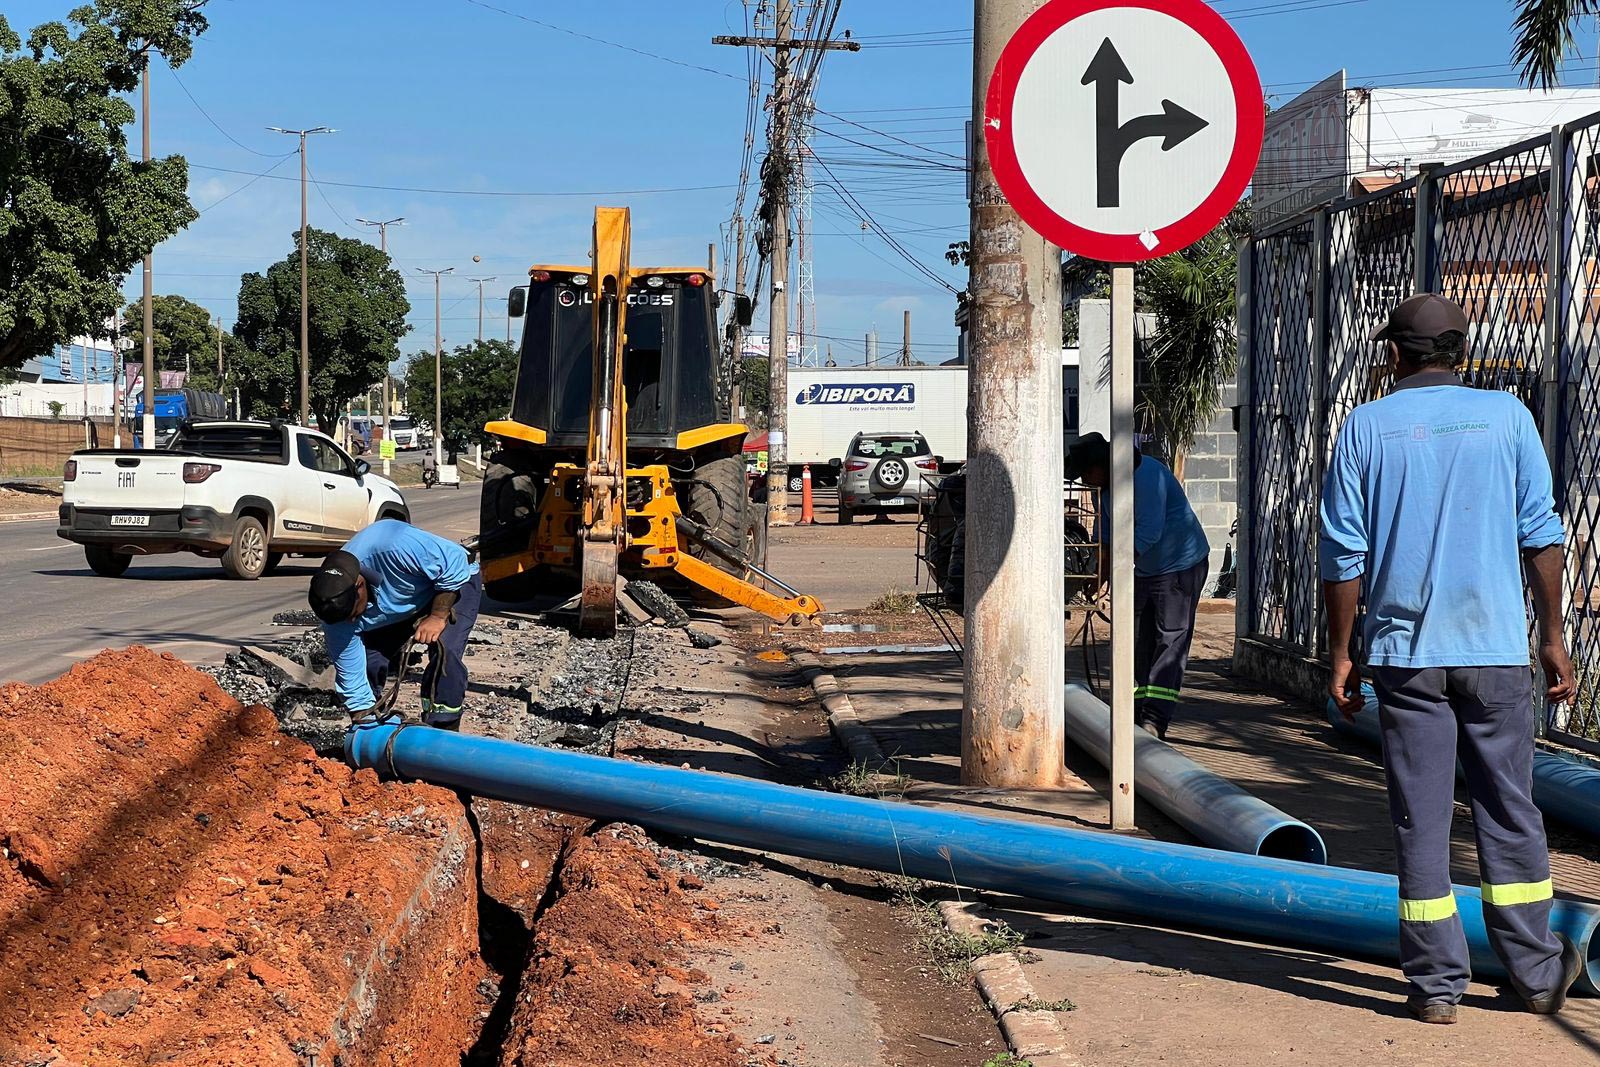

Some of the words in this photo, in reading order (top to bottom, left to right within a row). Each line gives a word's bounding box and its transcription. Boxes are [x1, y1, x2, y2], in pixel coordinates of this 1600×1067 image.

[820, 384, 910, 402] IBIPORÃ
[1460, 423, 1489, 431] GRANDE
[118, 471, 136, 488] FIAT
[114, 516, 146, 525] RHW9J82
